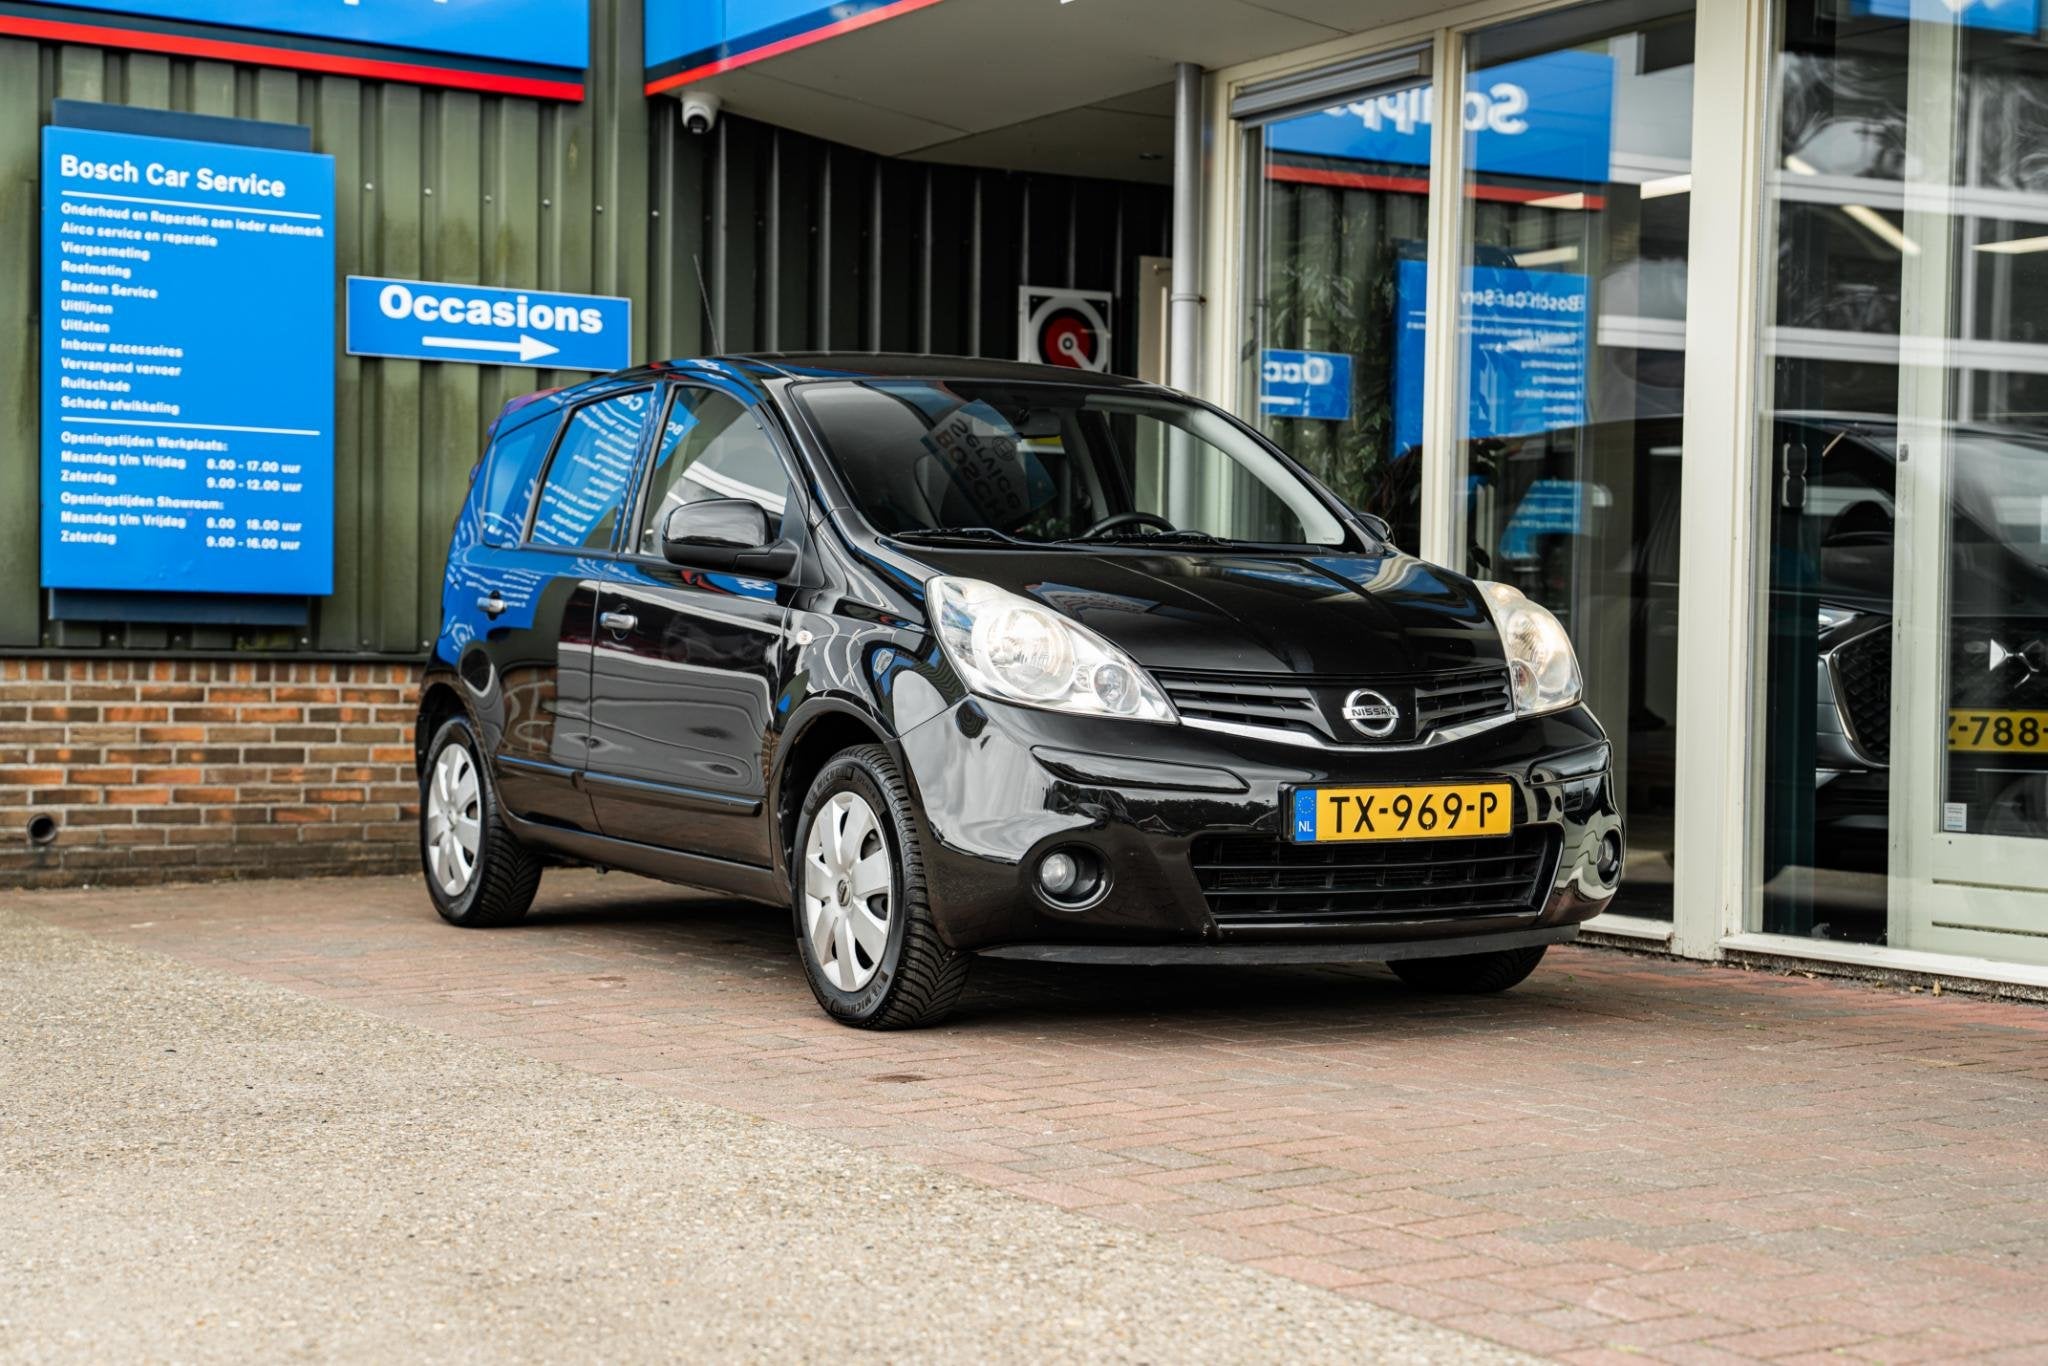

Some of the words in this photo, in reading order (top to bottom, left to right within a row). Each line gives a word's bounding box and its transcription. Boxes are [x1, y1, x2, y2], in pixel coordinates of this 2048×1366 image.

[61, 154, 139, 183] Bosch
[146, 163, 190, 186] Car
[196, 168, 286, 197] Service
[61, 202, 130, 220] Onderhoud
[132, 212, 148, 222] en
[150, 210, 209, 226] Reparatie
[211, 219, 234, 229] aan
[235, 220, 267, 232] ieder
[269, 223, 324, 236] automerk
[61, 222, 95, 235] Airco
[97, 227, 142, 240] service
[144, 231, 160, 242] en
[163, 231, 218, 246] reparatie
[61, 241, 151, 261] Viergasmeting
[61, 260, 132, 278] Roetmeting
[61, 280, 109, 295] Banden
[111, 283, 159, 298] Service
[61, 299, 113, 315] Uitlijnen
[379, 284, 604, 334] Occasions
[61, 319, 110, 333] Uitlaten
[61, 338, 107, 352] Inbouw
[109, 343, 184, 358] accessoires
[61, 357, 134, 374] Vervangend
[136, 364, 182, 376] vervoer
[61, 376, 132, 392] Ruitschade
[61, 395, 108, 410] Schade
[110, 399, 181, 415] afwikkeling
[61, 431, 155, 447] Openingstijden
[156, 435, 229, 451] Werkplaats:
[61, 450, 118, 466] Maandag
[119, 453, 141, 466] t/m
[142, 454, 187, 469] Vrijdag
[246, 461, 280, 473] 17.00
[281, 464, 302, 475] uur
[61, 469, 118, 485] Zaterdag
[282, 482, 303, 493] uur
[61, 491, 155, 508] Openingstijden
[156, 495, 225, 510] Showroom:
[61, 511, 118, 526] Maandag
[119, 513, 141, 526] t/m
[142, 514, 187, 529] Vrijdag
[281, 522, 302, 533] uur
[61, 530, 118, 545] Zaterdag
[280, 540, 301, 551] uur
[1351, 706, 1396, 717] NISSAN
[1329, 791, 1498, 833] TX-969-P
[1298, 821, 1313, 832] NL
